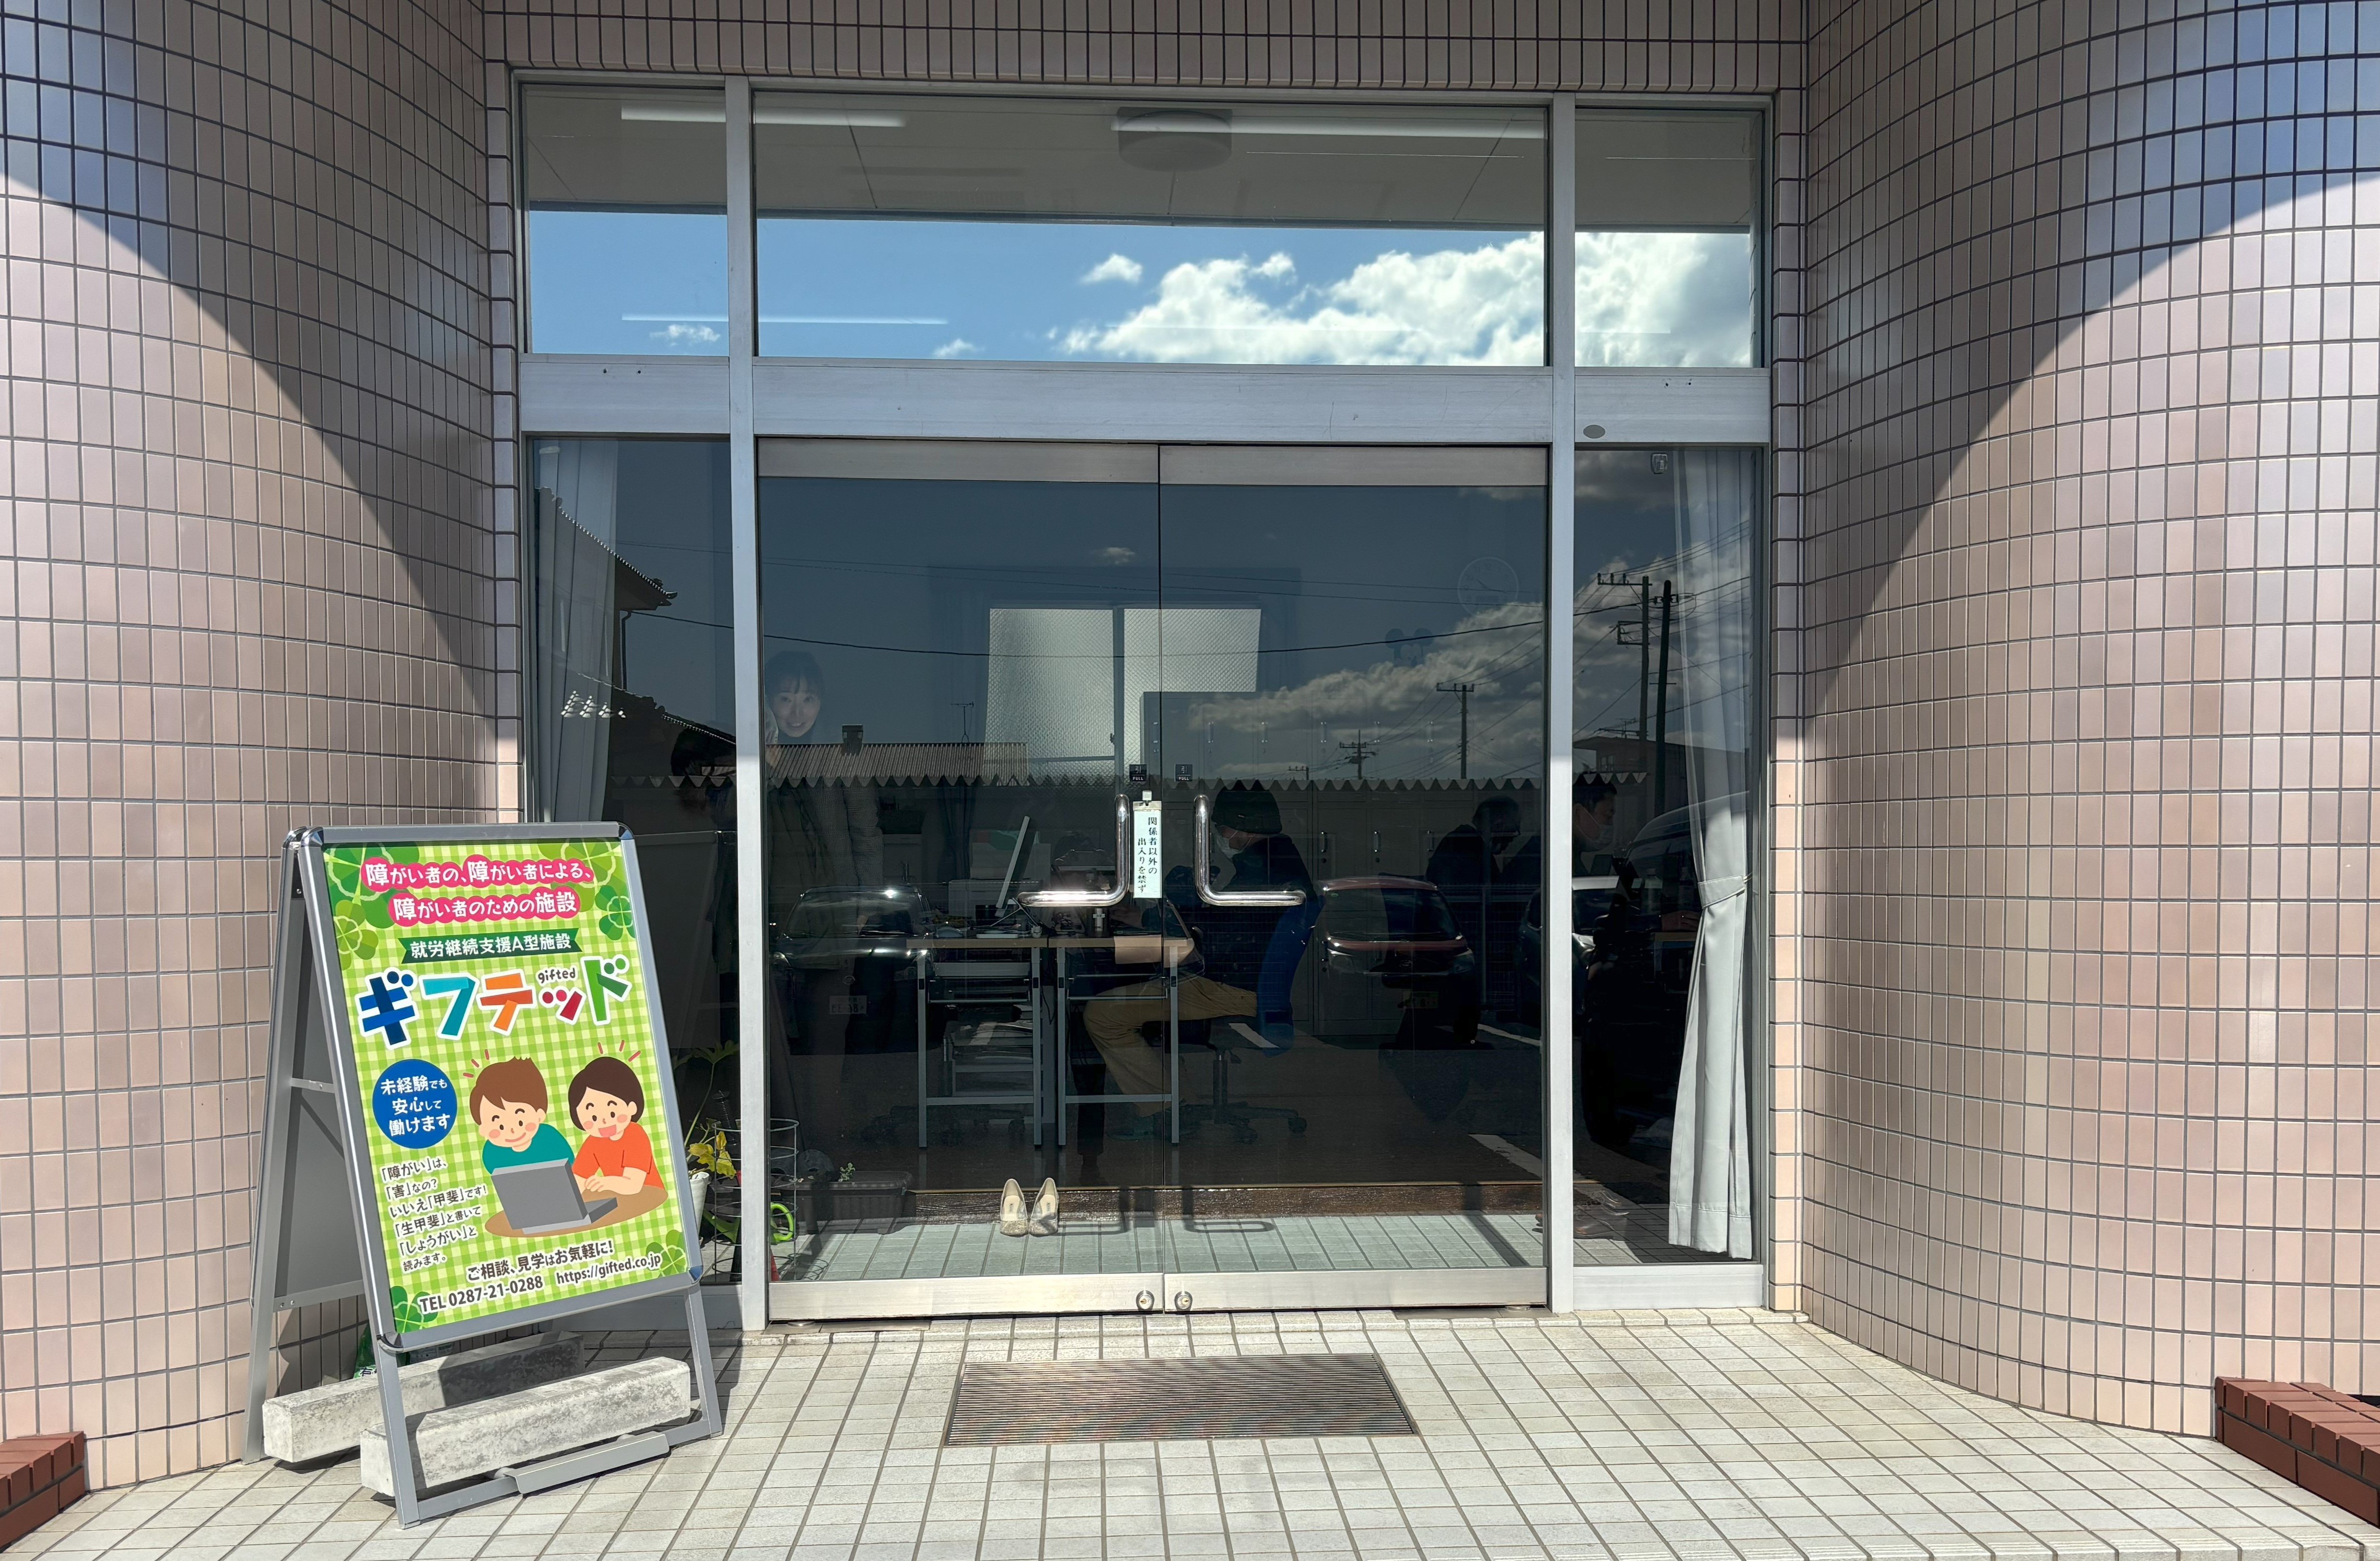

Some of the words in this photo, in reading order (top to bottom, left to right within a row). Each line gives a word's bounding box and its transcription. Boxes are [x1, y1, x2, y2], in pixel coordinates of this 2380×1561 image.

[1148, 817, 1158, 875] 関係者以外の
[366, 860, 592, 887] 障がい者の、障がい者による、
[1137, 837, 1147, 893] 出入りを禁ず
[393, 891, 577, 921] 障がい者のための施設
[410, 933, 572, 958] 就労継続支援A型施設
[538, 967, 576, 984] gifted
[358, 958, 629, 1046] ギフテッド
[380, 1075, 447, 1095] 未経験でも
[392, 1096, 442, 1115] 安心して
[389, 1113, 450, 1137] 働けます
[381, 1157, 446, 1181] 「障がい」は、
[386, 1178, 437, 1200] 「害」なの?
[389, 1185, 487, 1218] いいえ「甲斐」です!
[395, 1206, 481, 1237] 「生甲斐」と書いて
[400, 1226, 477, 1256] 「しょうがい」と
[403, 1253, 446, 1272] 読みます。
[467, 1240, 614, 1281] ご相談、見学はお気軽に!
[557, 1253, 661, 1285] https://gifted.co.jp
[419, 1296, 446, 1312] TEL
[449, 1275, 543, 1307] 0287-21-0288
